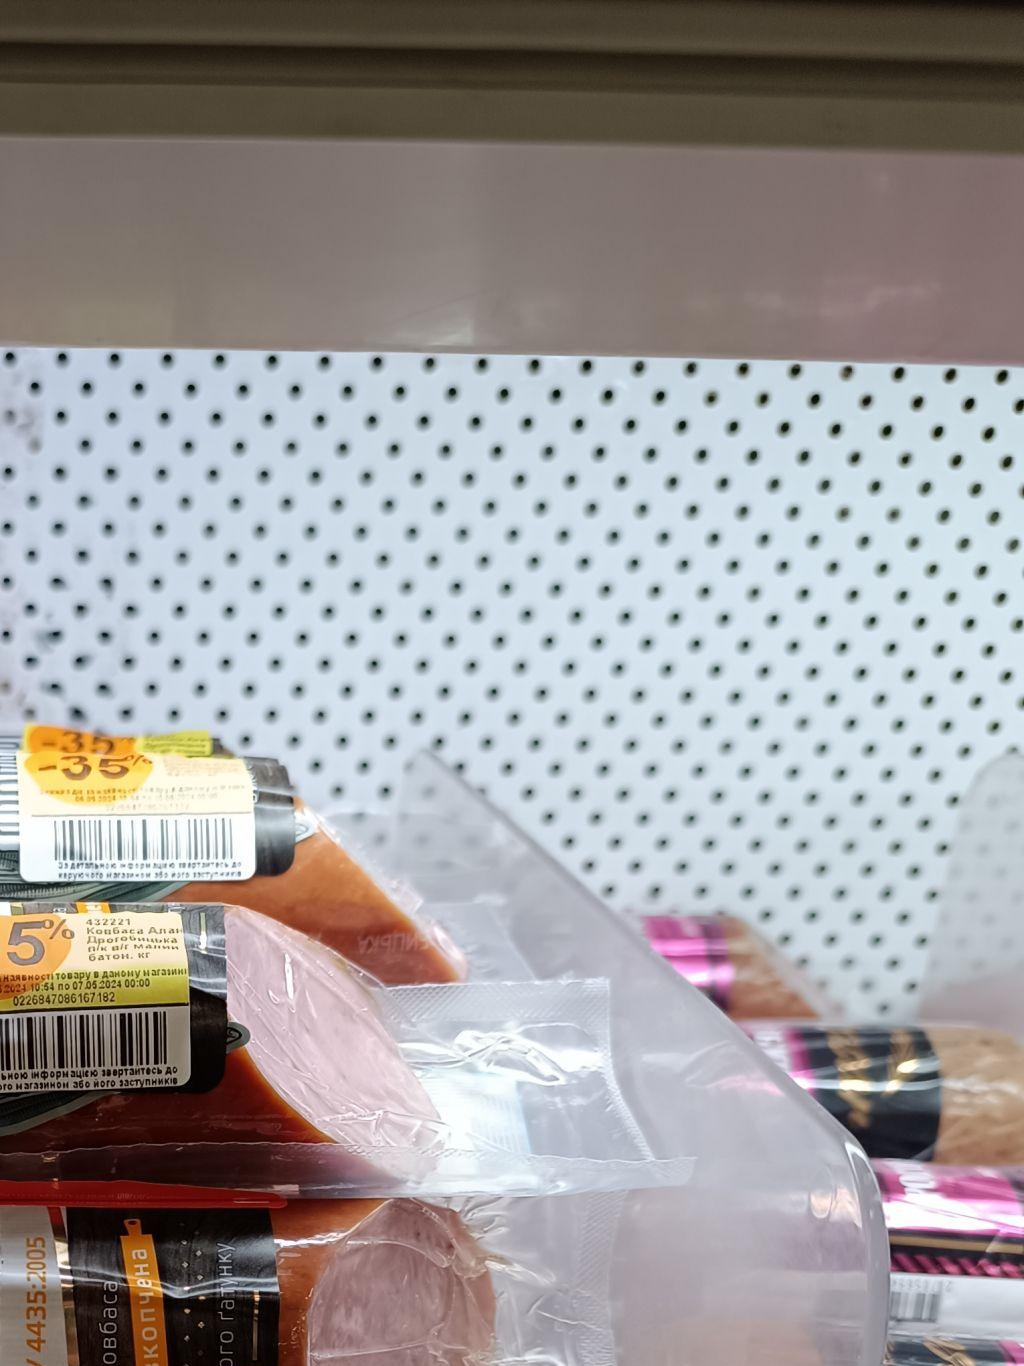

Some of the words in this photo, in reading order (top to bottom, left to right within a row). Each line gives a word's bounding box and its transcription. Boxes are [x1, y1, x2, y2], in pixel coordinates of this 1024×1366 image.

[86, 918, 131, 926] 432221
[124, 978, 150, 988] 00:00
[25, 1236, 47, 1353] 4435:2005
[215, 1241, 237, 1321] ґатунку
